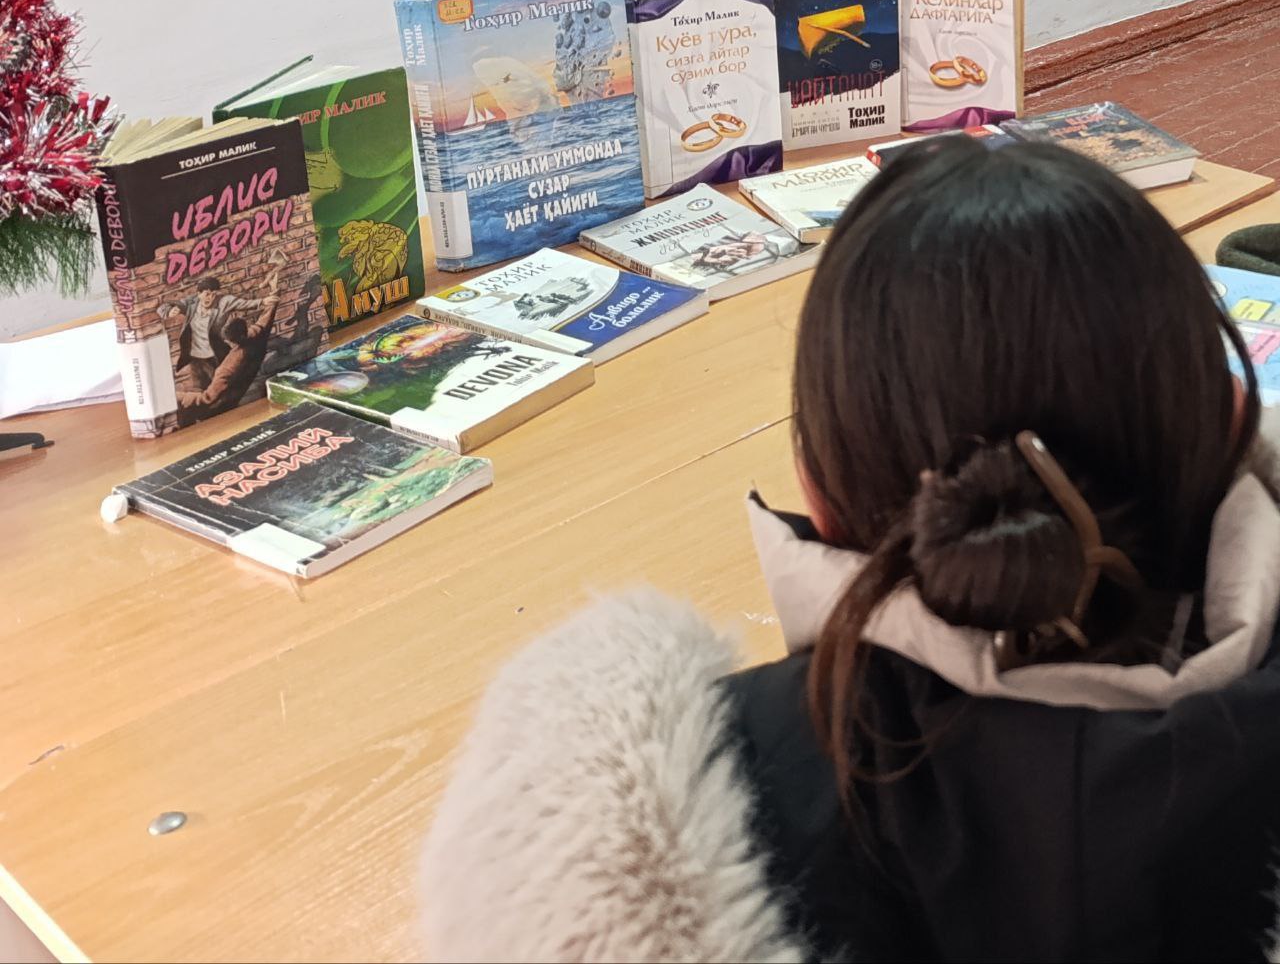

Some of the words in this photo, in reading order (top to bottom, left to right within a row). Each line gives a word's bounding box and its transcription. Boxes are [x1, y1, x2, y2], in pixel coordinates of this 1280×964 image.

[704, 10, 740, 21] Малик
[910, 7, 993, 24] ДАФТАРИГА
[656, 31, 703, 55] Куёв
[708, 25, 757, 45] тўра,
[666, 53, 704, 68] сизга
[709, 45, 750, 61] айтар
[671, 66, 714, 84] сўзим
[718, 61, 747, 73] бор
[323, 90, 386, 118] МАЛИК
[849, 115, 885, 129] Малик
[178, 152, 216, 169] ТОҲИР
[218, 141, 257, 159] МАЛИК
[466, 154, 550, 189] ПЎРТАНАЛИ
[554, 138, 623, 169] УММОНДА
[528, 174, 570, 200] СУЗАР
[172, 167, 278, 241] ИБЛИС
[504, 202, 539, 232] ҲАЁТ
[543, 190, 599, 222] ҚАЙИҒИ
[628, 213, 687, 235] МАЛИК
[165, 199, 294, 284] ДЕВОРИ
[113, 256, 135, 313] ИБЛИС
[484, 263, 553, 294] МАЛИК
[443, 354, 544, 400] DEVONA
[230, 429, 277, 452] МАЛИК
[195, 427, 333, 498] АЗАЛИЙ
[208, 436, 355, 506] НАСИБА
